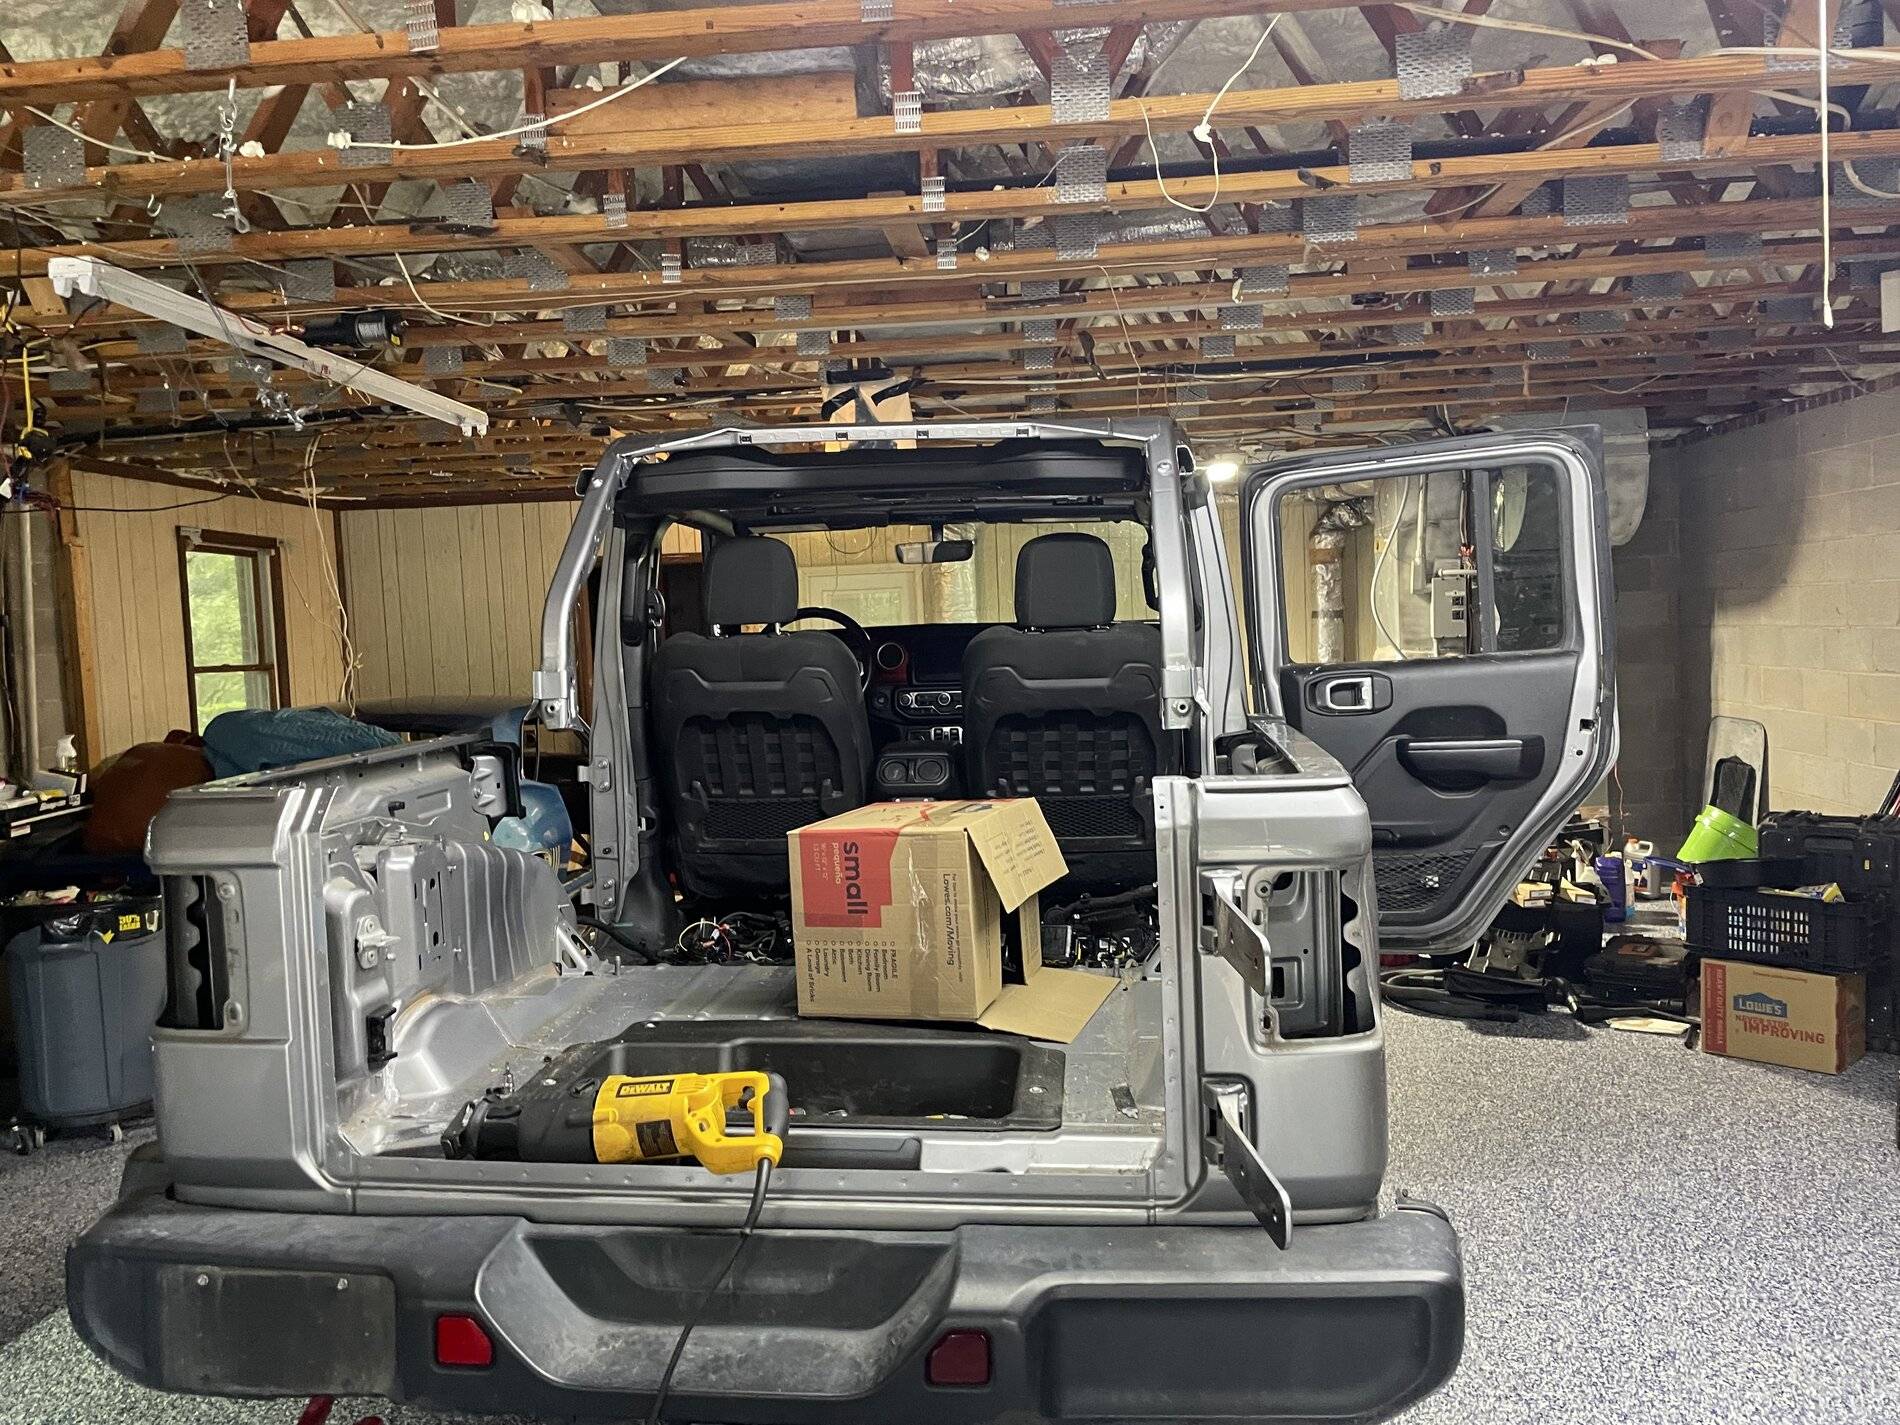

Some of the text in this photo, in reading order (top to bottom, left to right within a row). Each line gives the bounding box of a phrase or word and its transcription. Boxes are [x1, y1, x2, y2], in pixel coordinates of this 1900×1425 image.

[832, 842, 842, 884] pequeño
[844, 842, 868, 914] small
[943, 874, 956, 966] Lowes.com/Moving
[1739, 998, 1782, 1015] LOWE'S
[1743, 1020, 1825, 1044] IMPROVING
